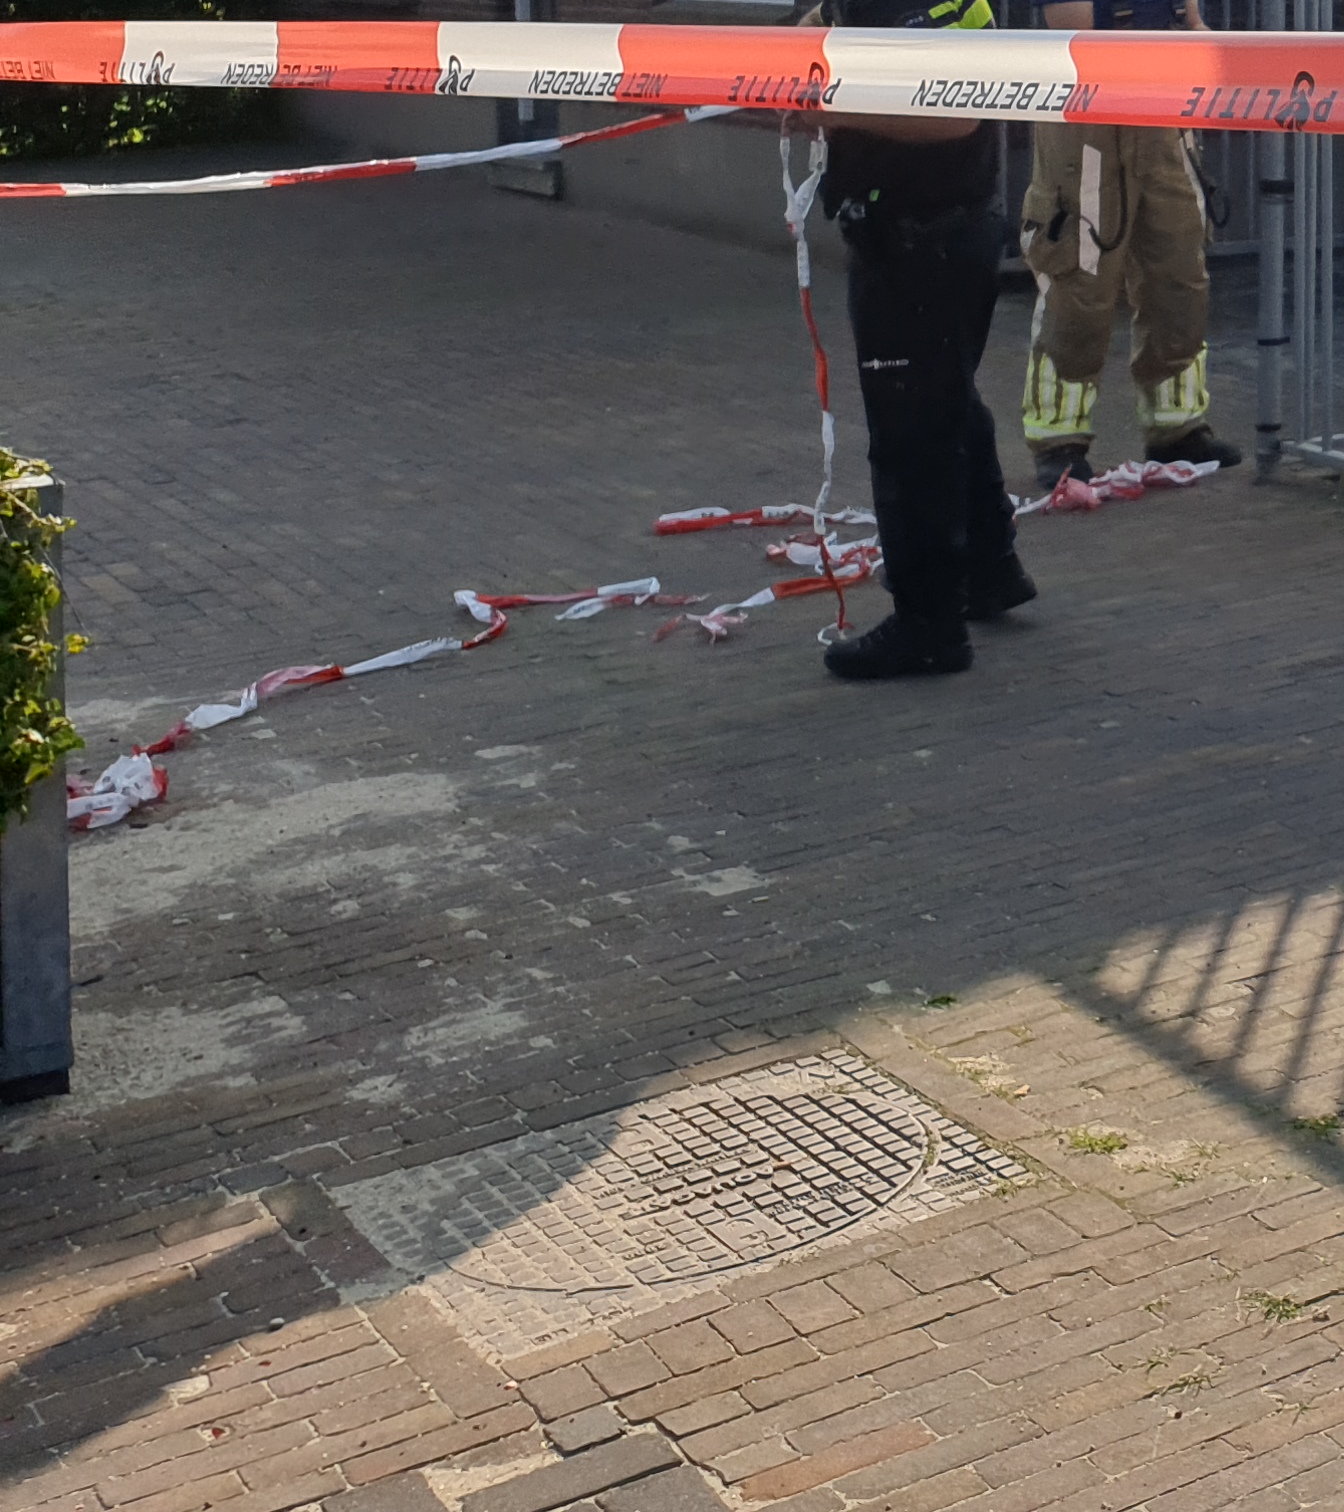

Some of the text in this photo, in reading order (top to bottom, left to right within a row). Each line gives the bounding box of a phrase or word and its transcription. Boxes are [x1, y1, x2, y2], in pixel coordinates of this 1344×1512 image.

[528, 69, 668, 98] NIET BETREDEN
[911, 78, 1099, 113] NIET BETREDEN
